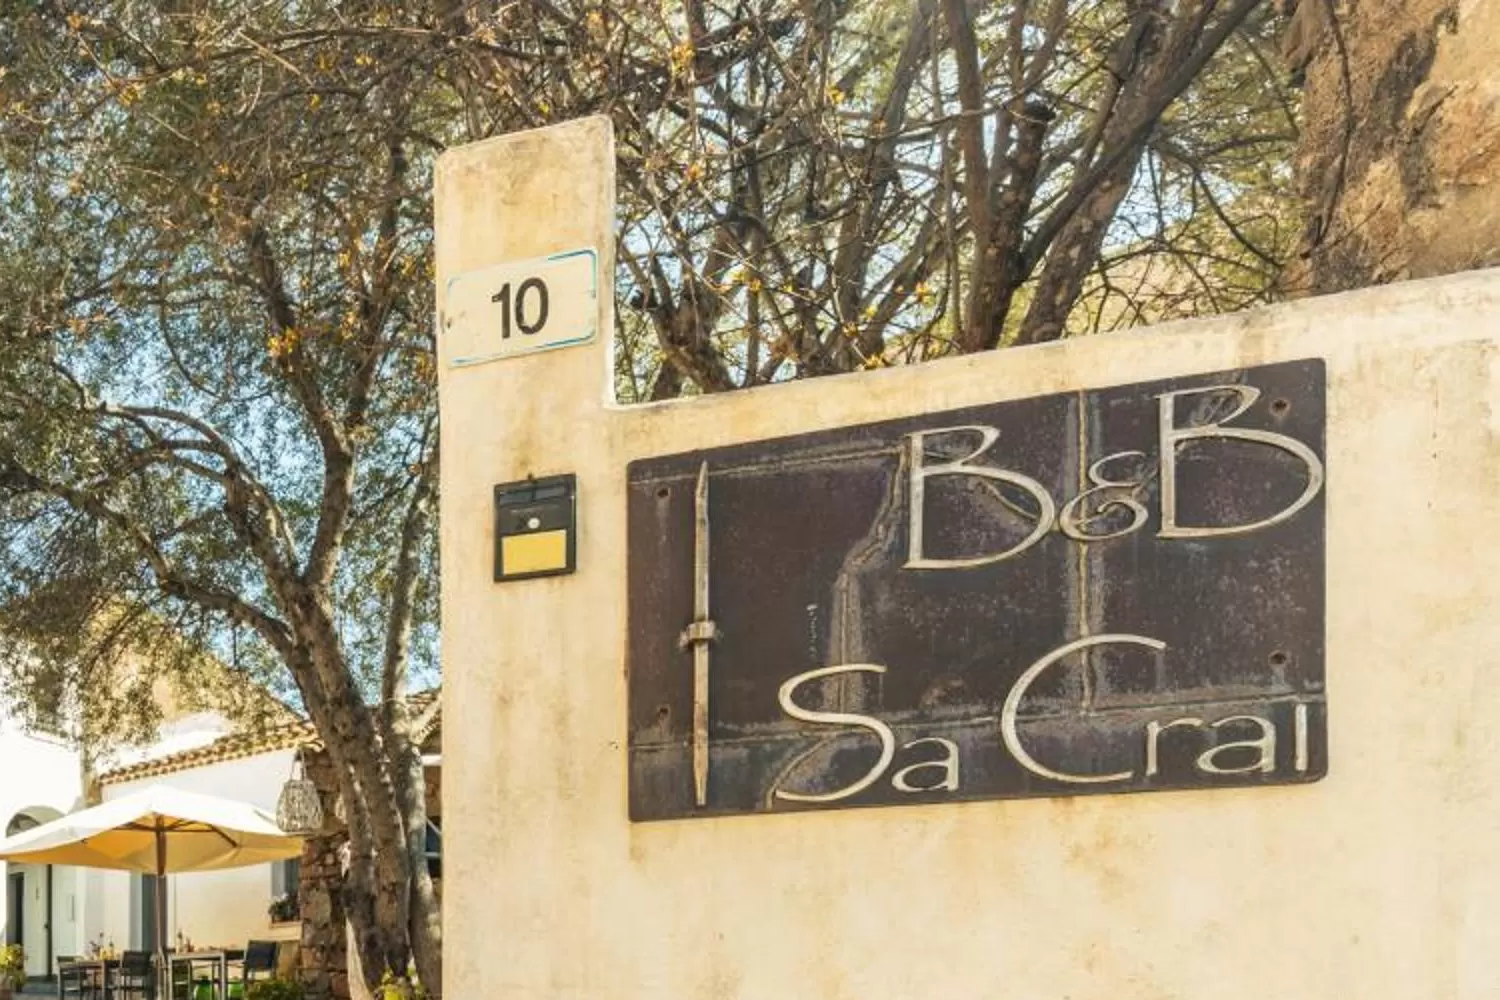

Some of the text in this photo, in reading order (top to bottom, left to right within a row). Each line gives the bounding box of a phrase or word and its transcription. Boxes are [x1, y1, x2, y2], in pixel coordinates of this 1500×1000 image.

[491, 277, 549, 339] 10
[901, 384, 1325, 570] B&B
[775, 663, 960, 802] Sa
